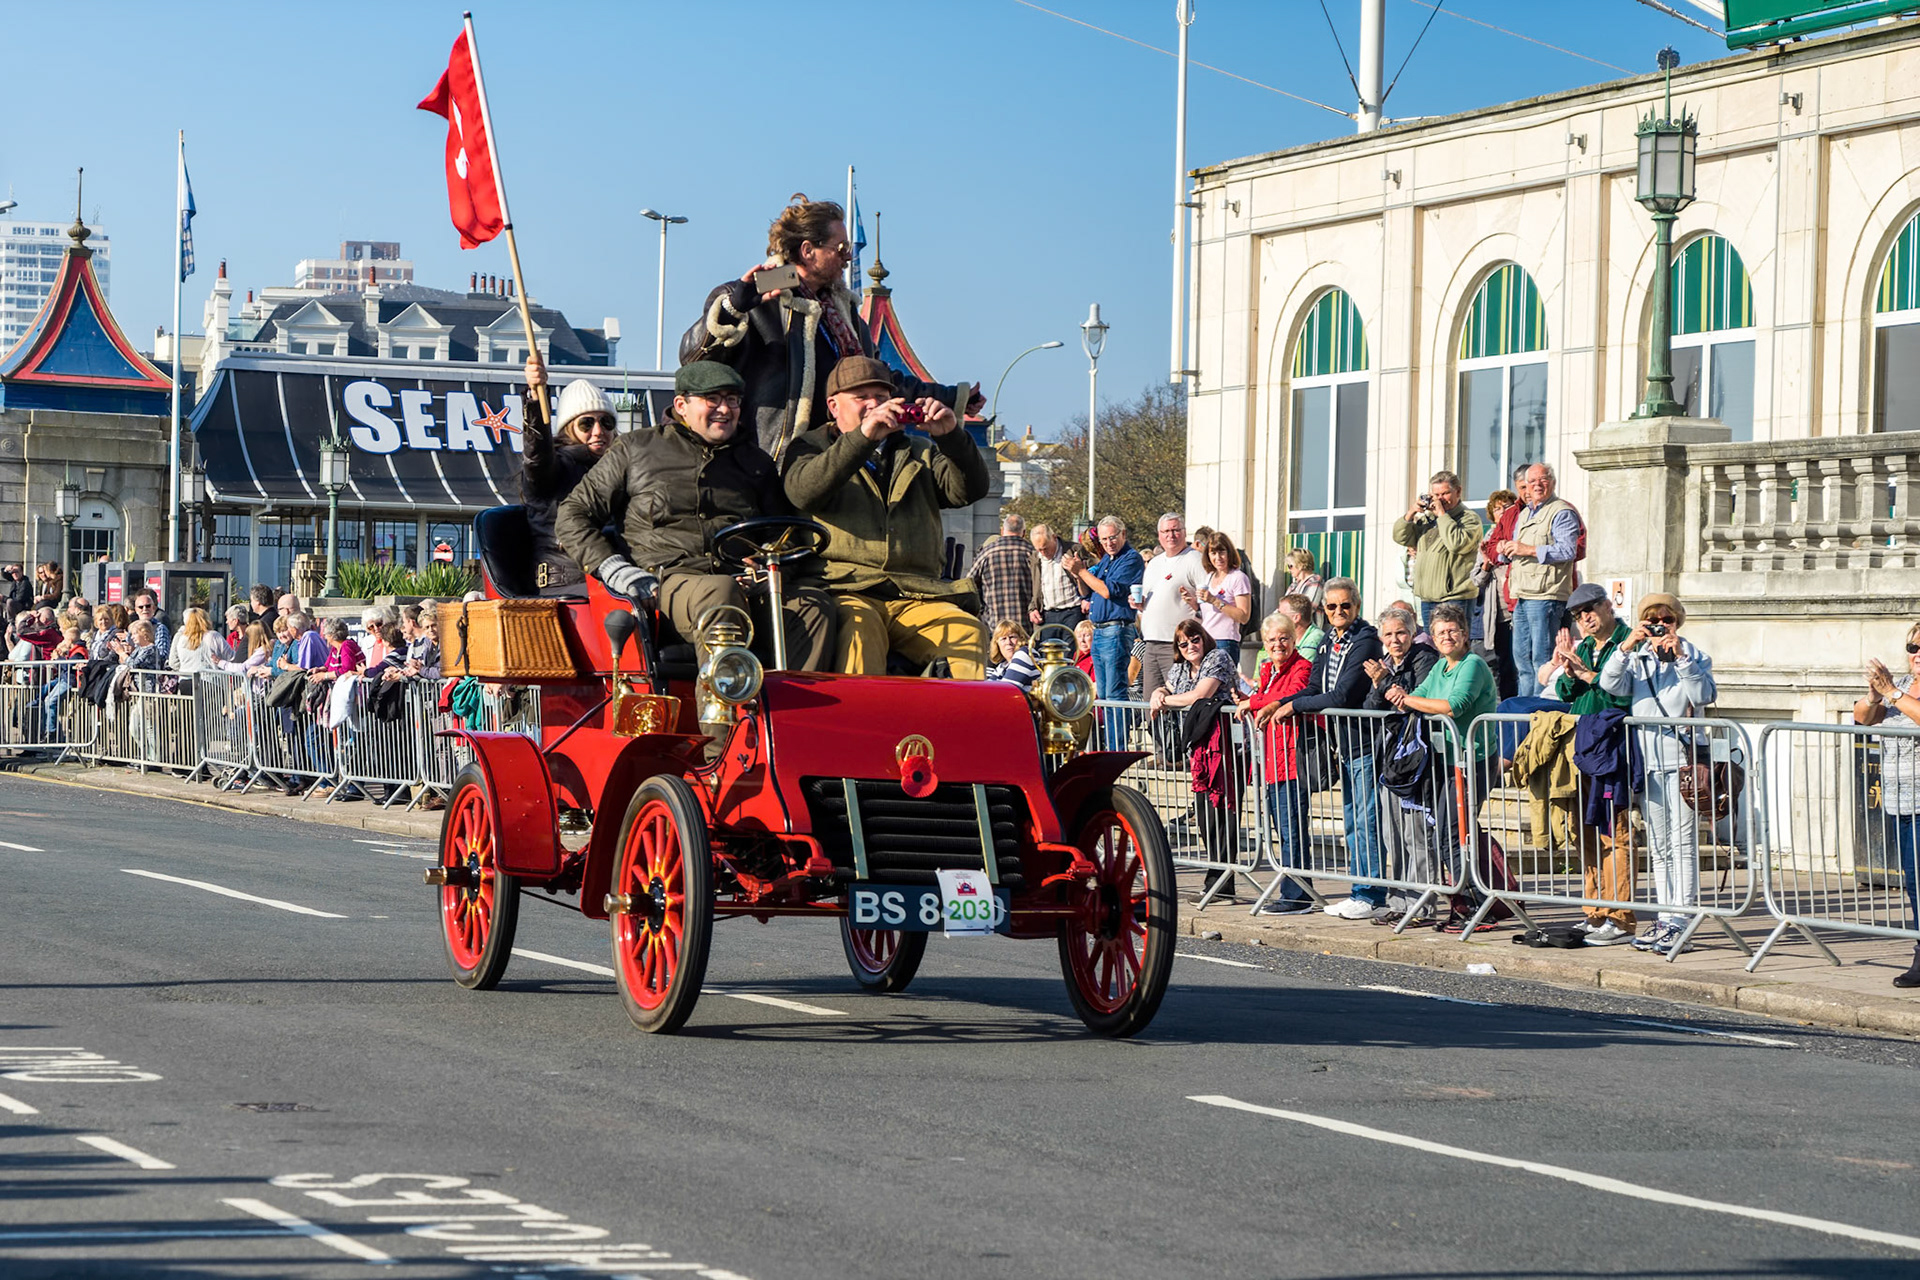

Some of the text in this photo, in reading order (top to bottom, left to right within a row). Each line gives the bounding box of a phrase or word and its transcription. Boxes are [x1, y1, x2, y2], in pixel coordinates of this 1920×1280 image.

[344, 380, 494, 453] SEA
[855, 891, 906, 924] BS
[948, 899, 991, 920] 203
